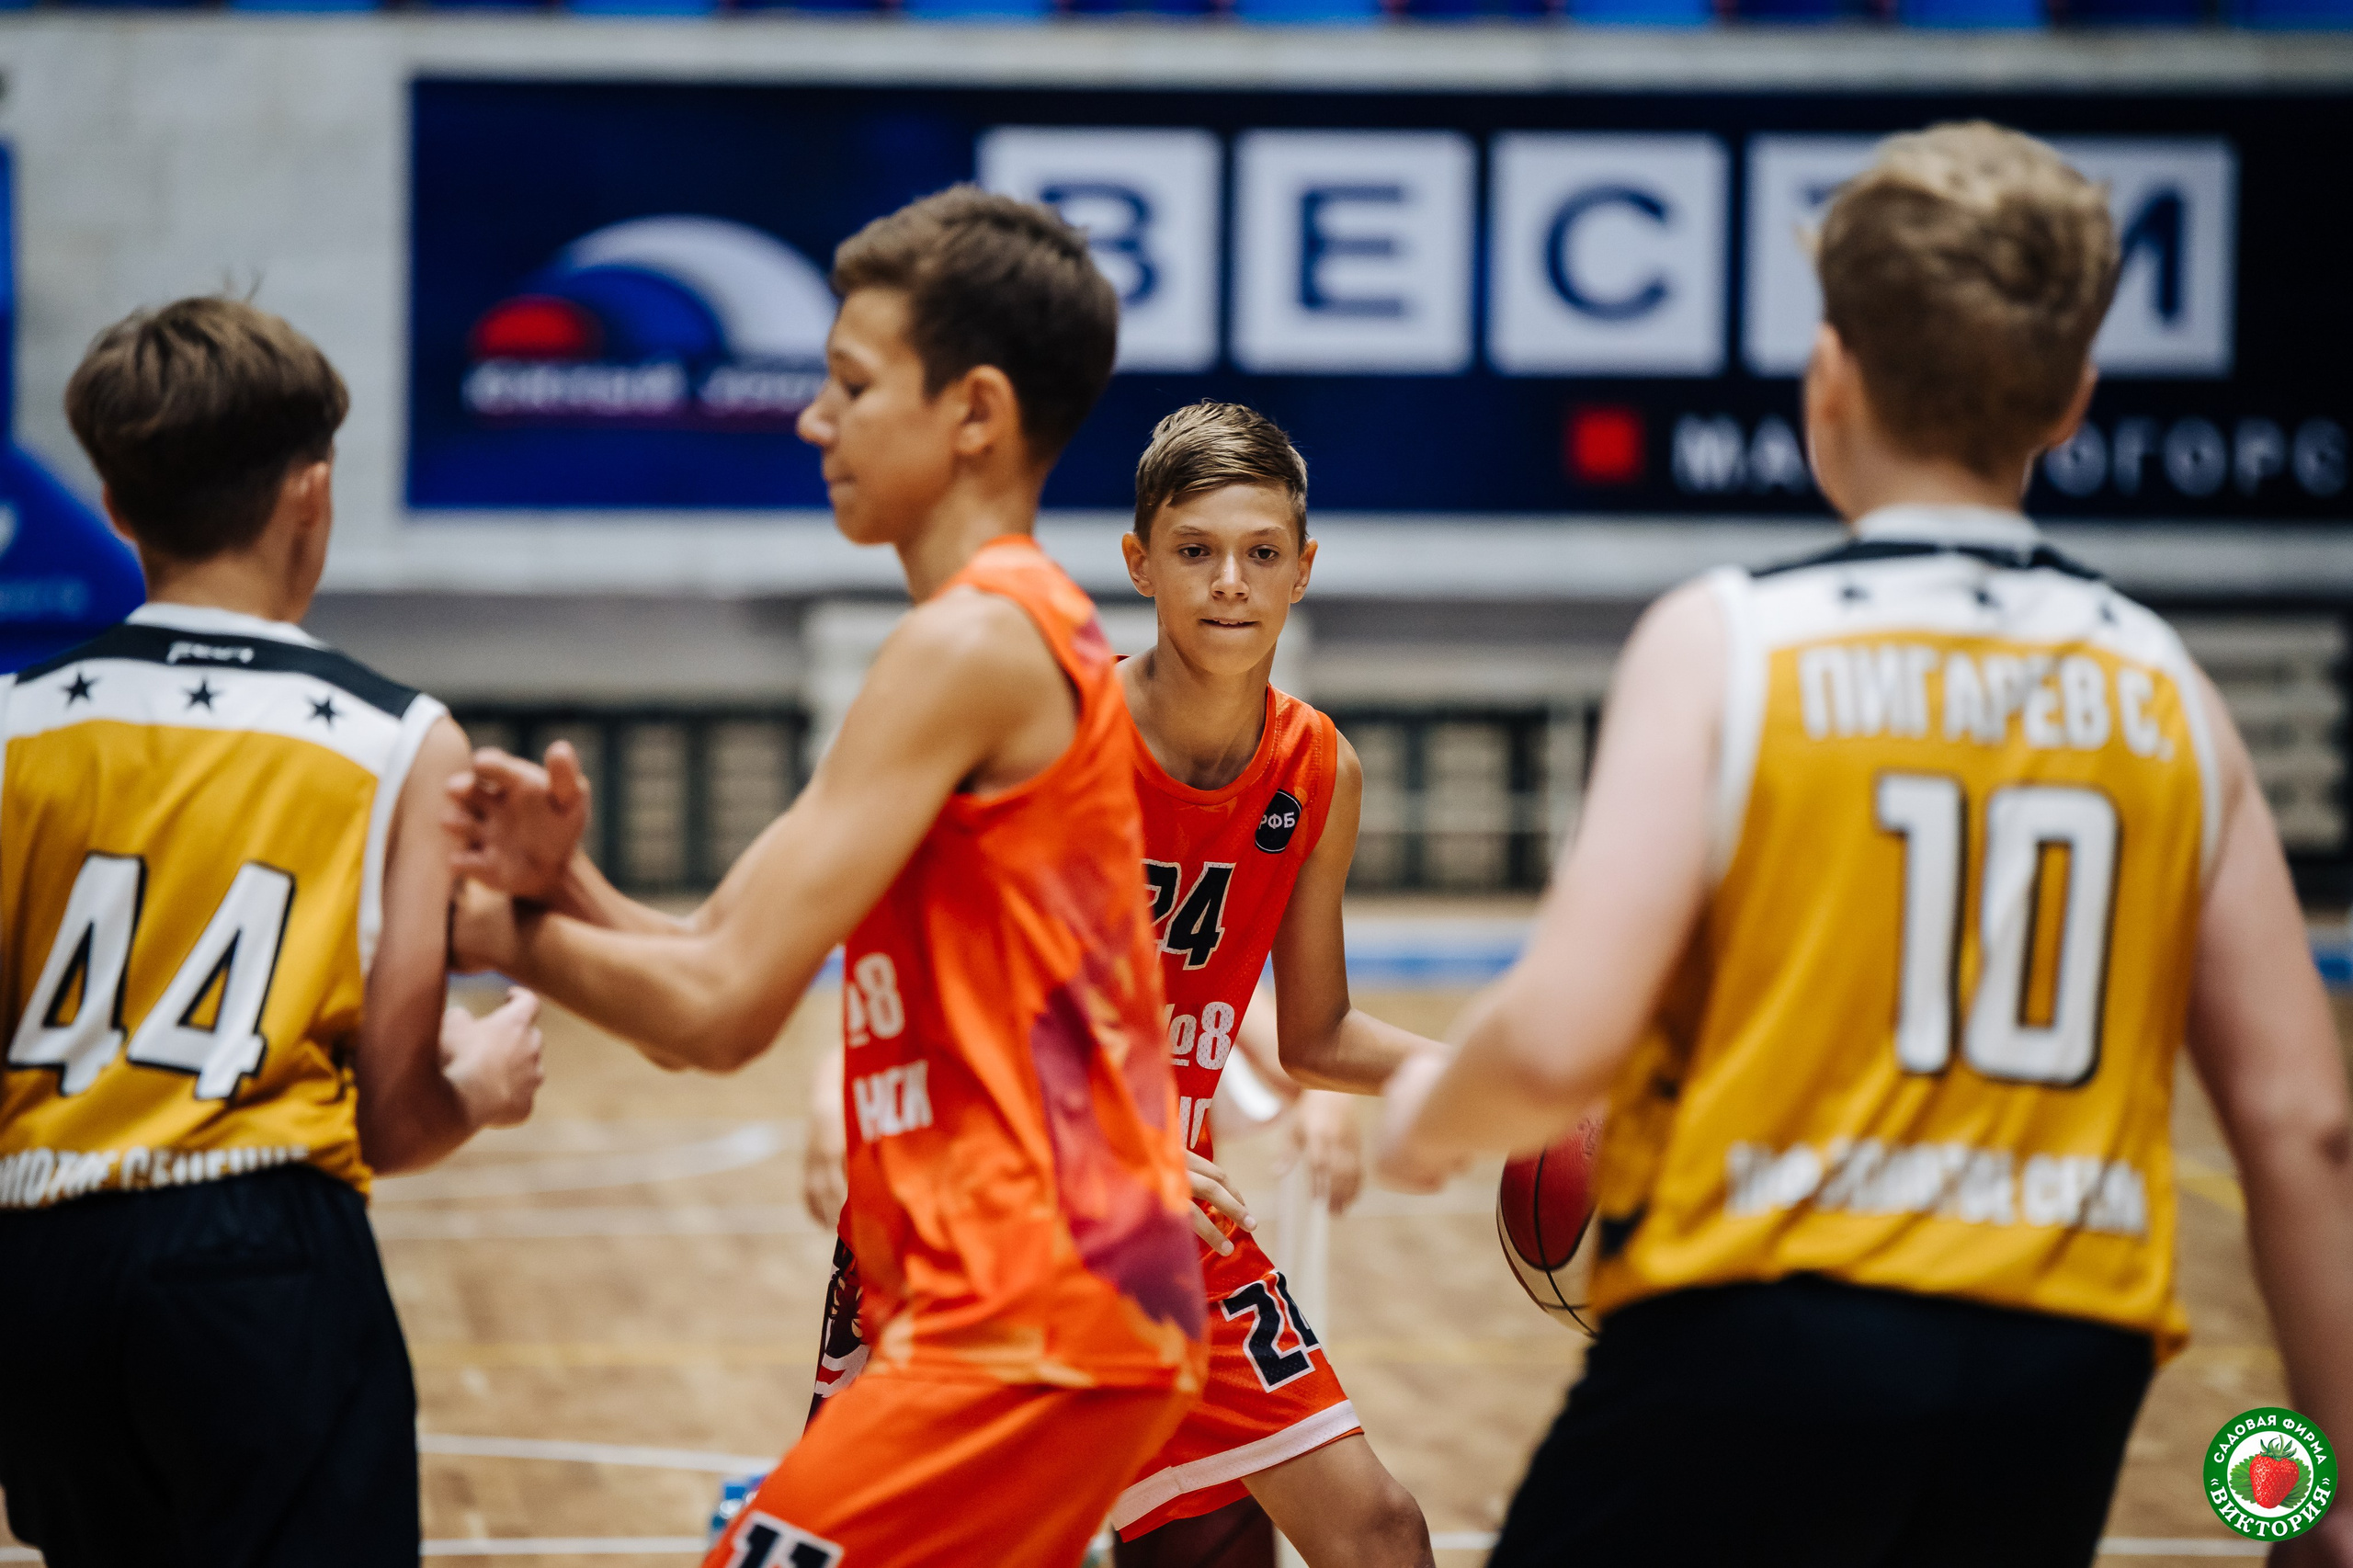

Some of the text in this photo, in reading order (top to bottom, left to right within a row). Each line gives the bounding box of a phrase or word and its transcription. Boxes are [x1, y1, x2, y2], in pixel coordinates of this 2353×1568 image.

[1800, 645, 2112, 752] ПИГАРЕВ
[7, 850, 297, 1101] 44
[1875, 768, 2123, 1090] 10
